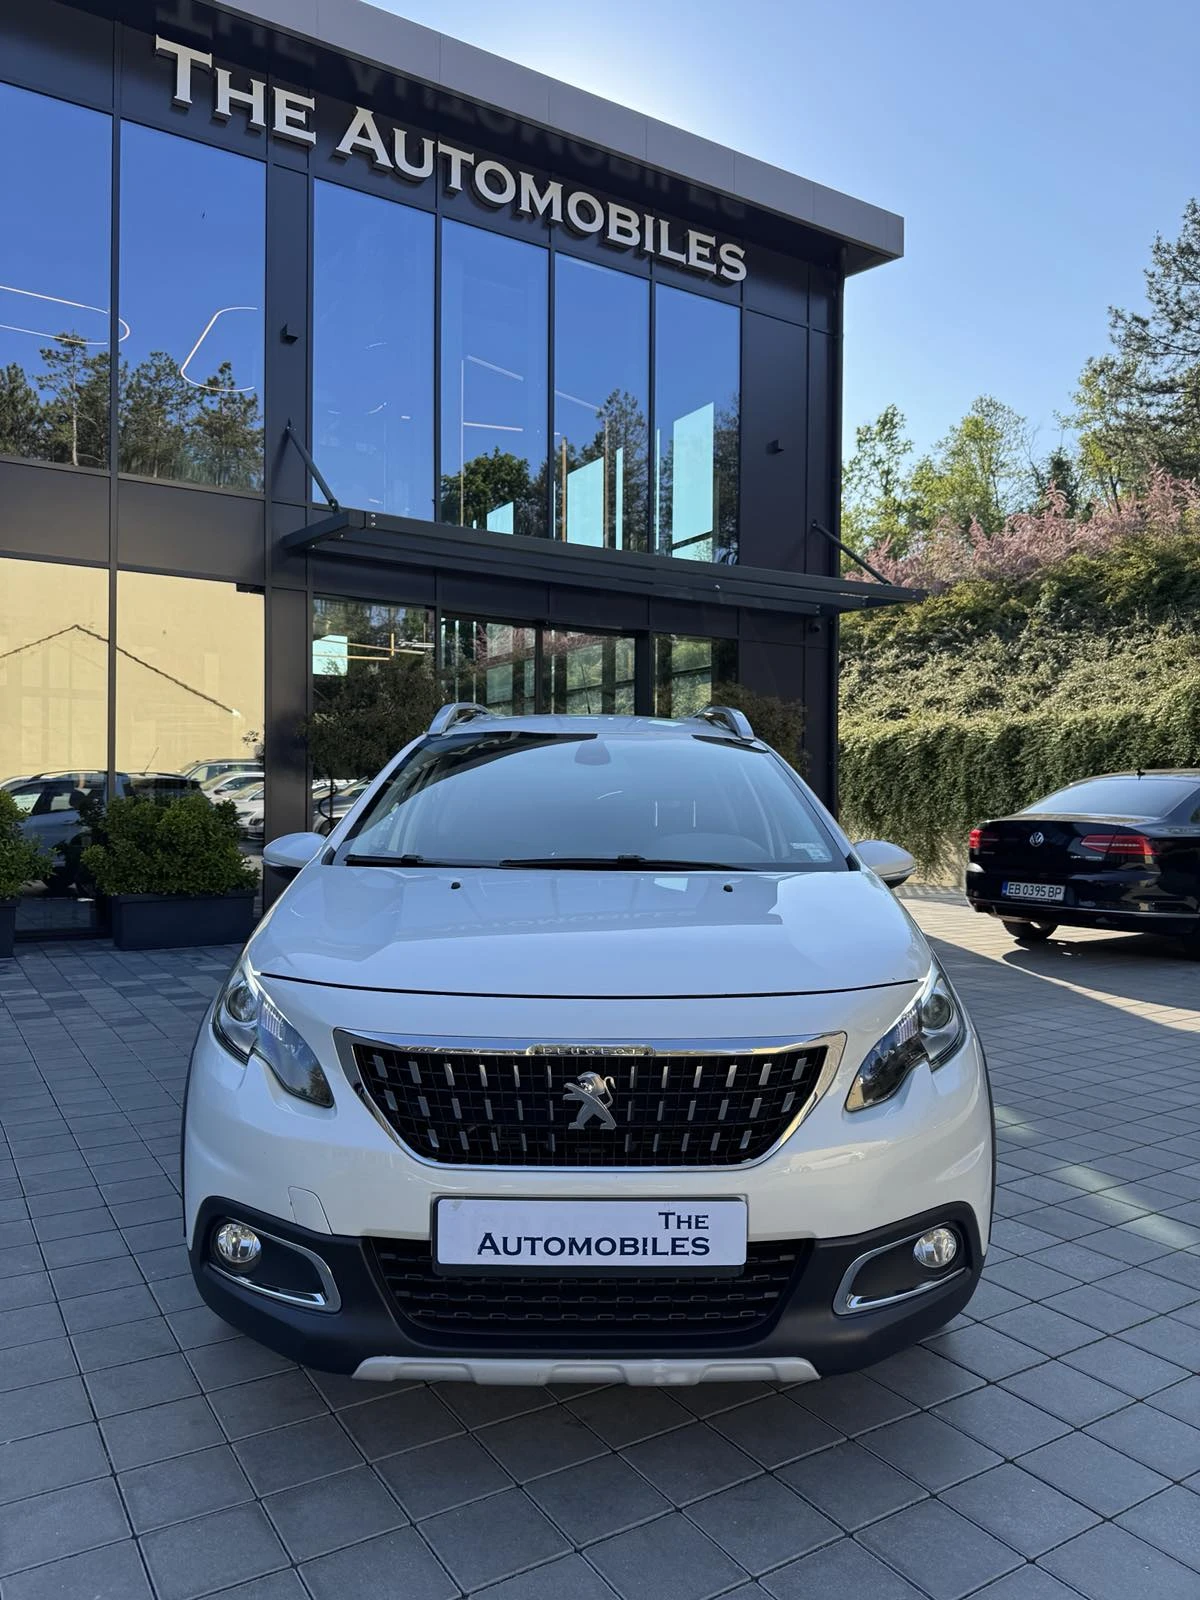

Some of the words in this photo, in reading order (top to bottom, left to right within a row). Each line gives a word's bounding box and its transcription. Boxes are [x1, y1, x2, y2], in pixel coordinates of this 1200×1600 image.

[155, 34, 317, 145] THE
[335, 106, 748, 281] AUTOMOBILES
[1008, 883, 1021, 895] EB
[1022, 884, 1047, 897] 0395
[1048, 886, 1062, 898] BP
[542, 1047, 639, 1056] PEUGEOT
[658, 1212, 709, 1229] THE
[477, 1232, 711, 1256] AUTOMOBILES
